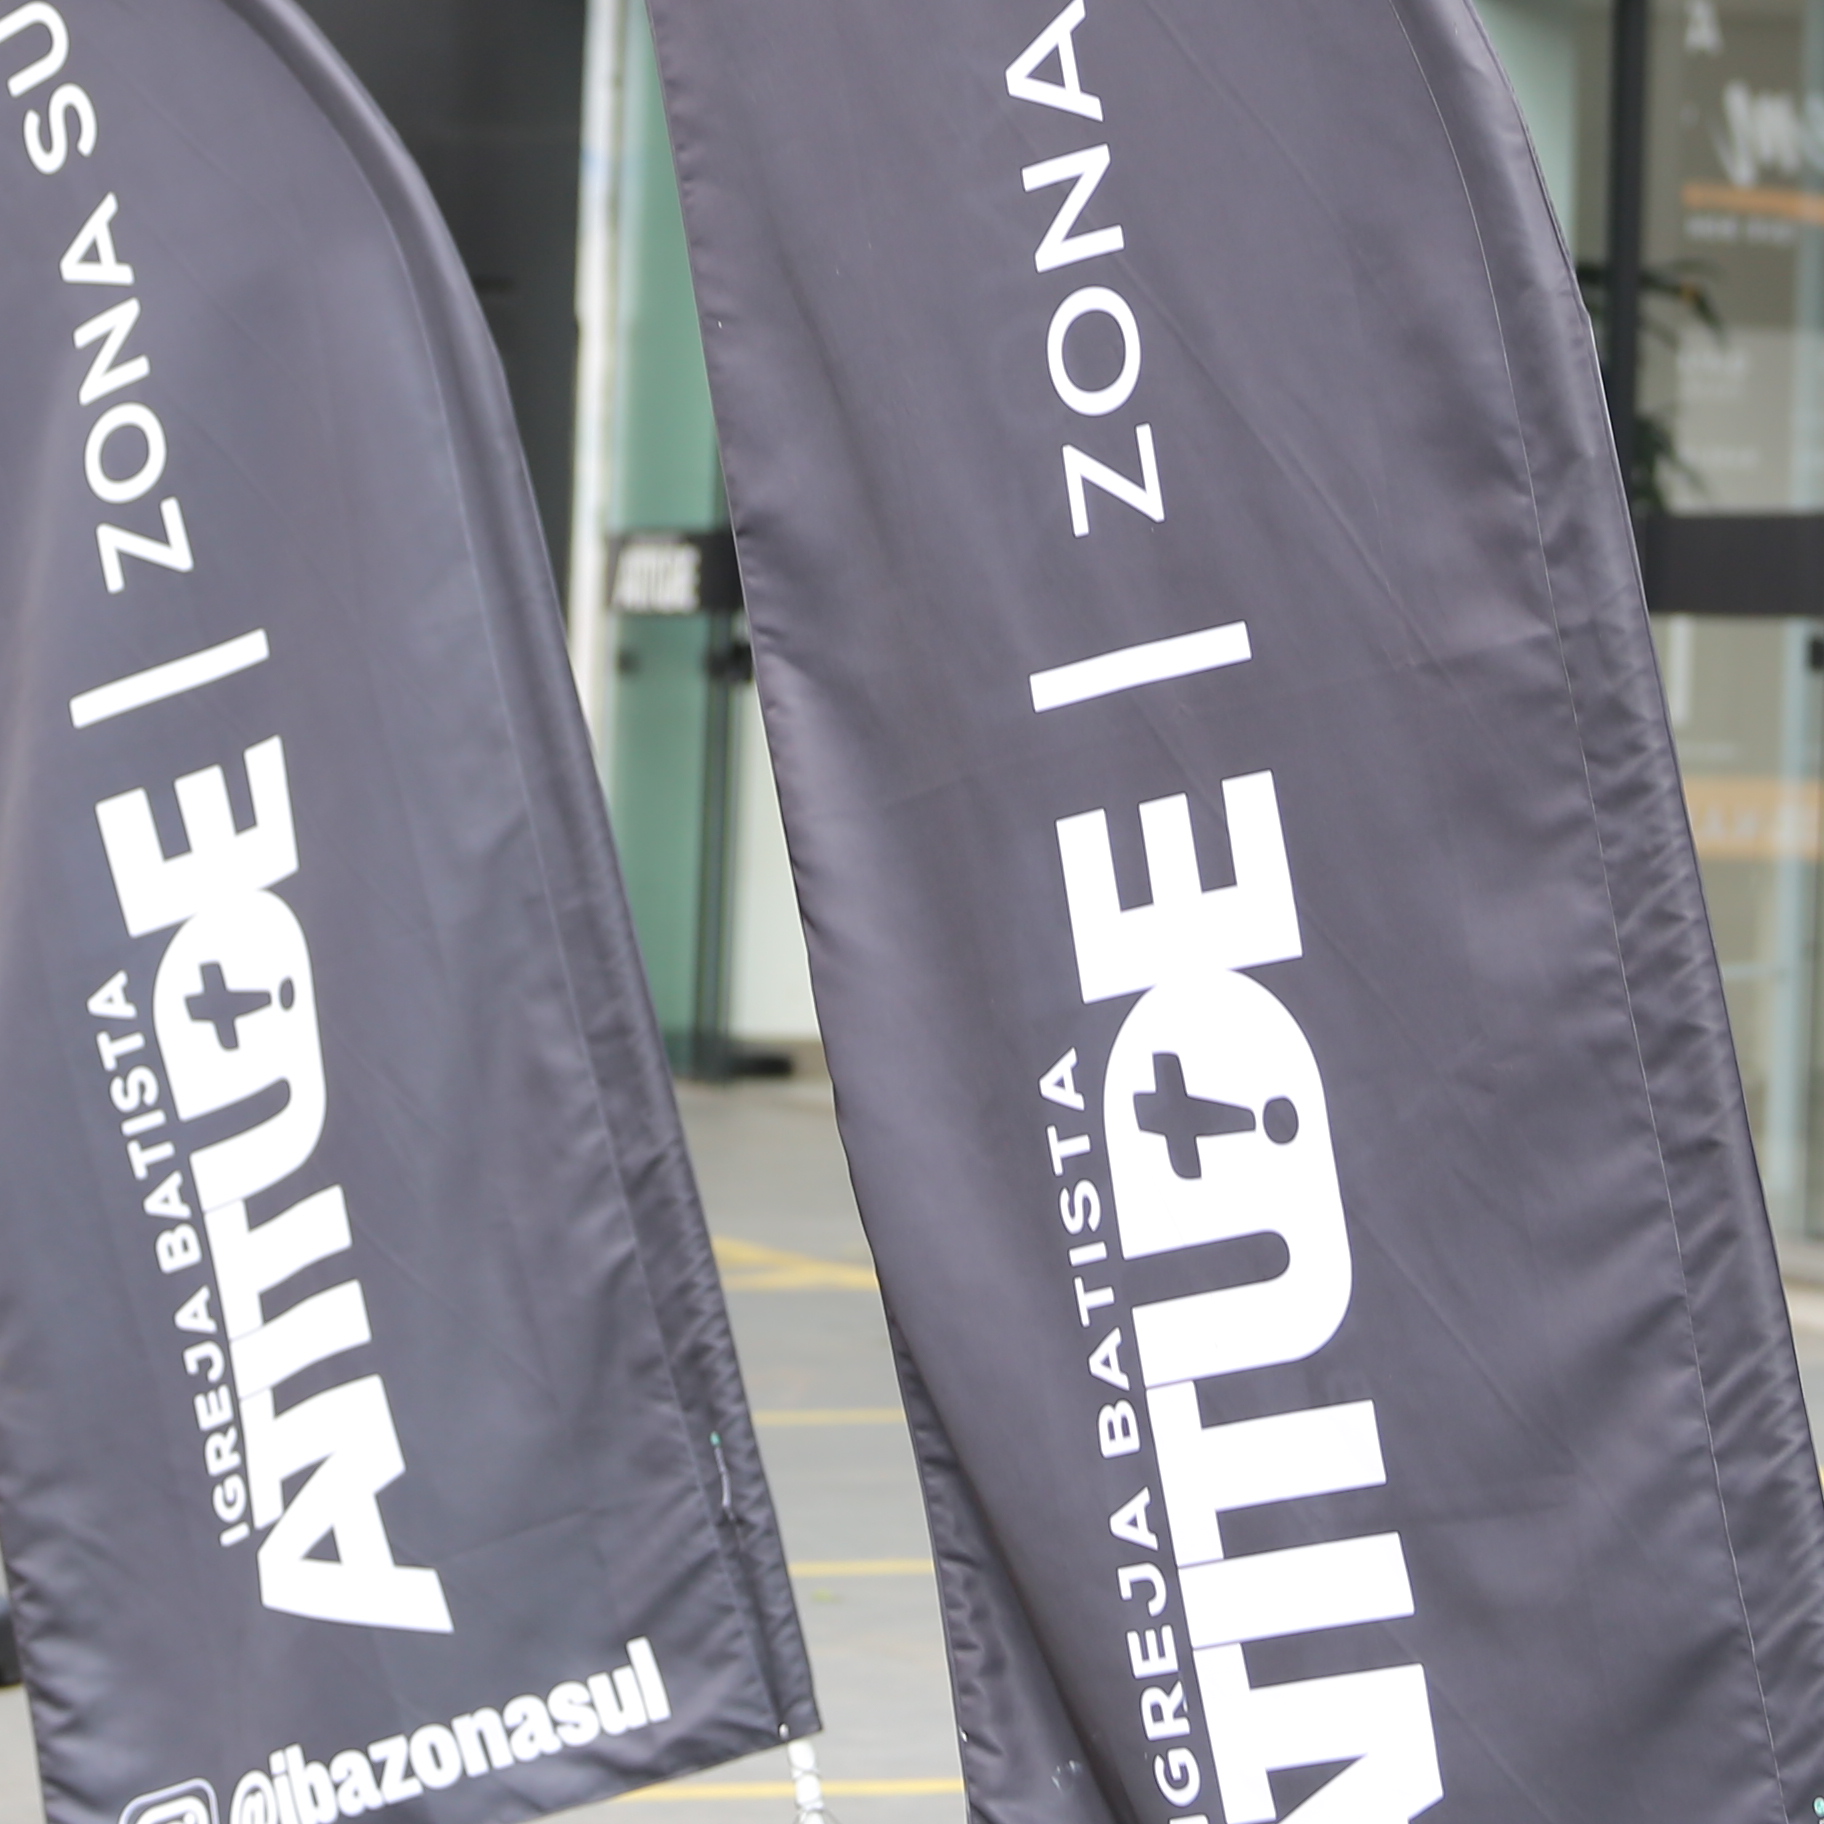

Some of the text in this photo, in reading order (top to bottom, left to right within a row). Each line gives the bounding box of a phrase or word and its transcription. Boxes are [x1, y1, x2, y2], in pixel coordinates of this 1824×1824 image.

[59, 191, 194, 594] ZONA
[86, 969, 251, 1548] IGREJA BATISTA
[94, 734, 455, 1634] ATITUDE
[1039, 1046, 1142, 1459] BATISTA
